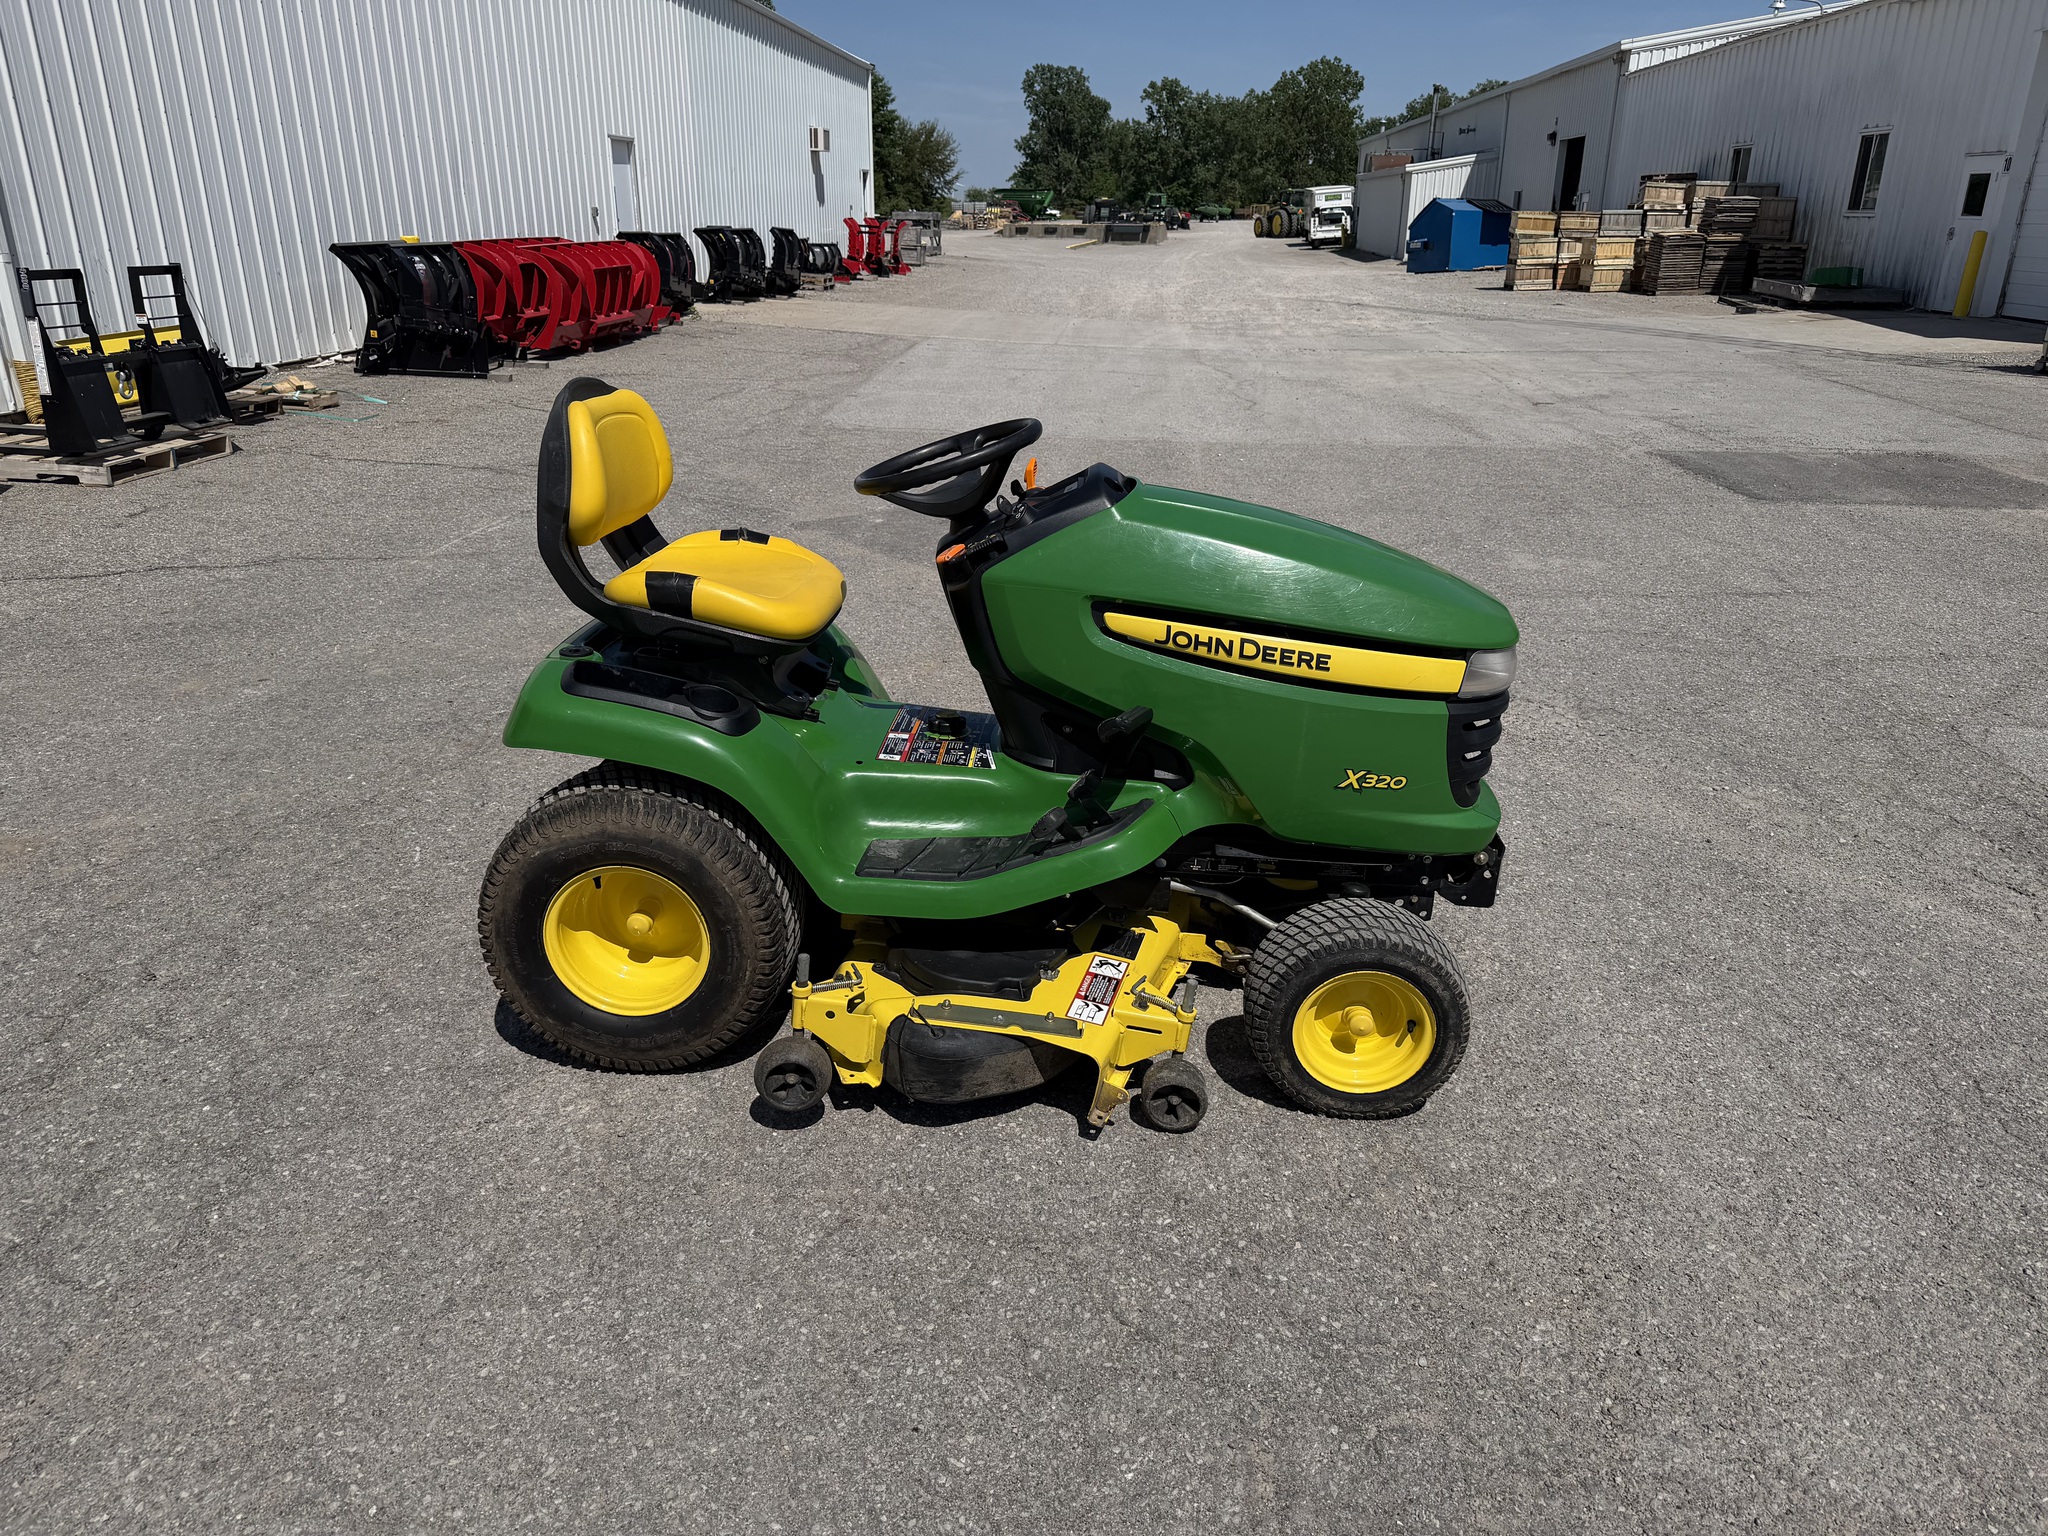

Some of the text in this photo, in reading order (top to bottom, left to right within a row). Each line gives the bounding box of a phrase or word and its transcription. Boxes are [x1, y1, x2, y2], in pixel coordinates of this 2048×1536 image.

[2003, 156, 2013, 172] 10
[1154, 625, 1332, 672] JOHN DEERE
[1336, 768, 1408, 791] X320
[1079, 975, 1092, 992] DANGER
